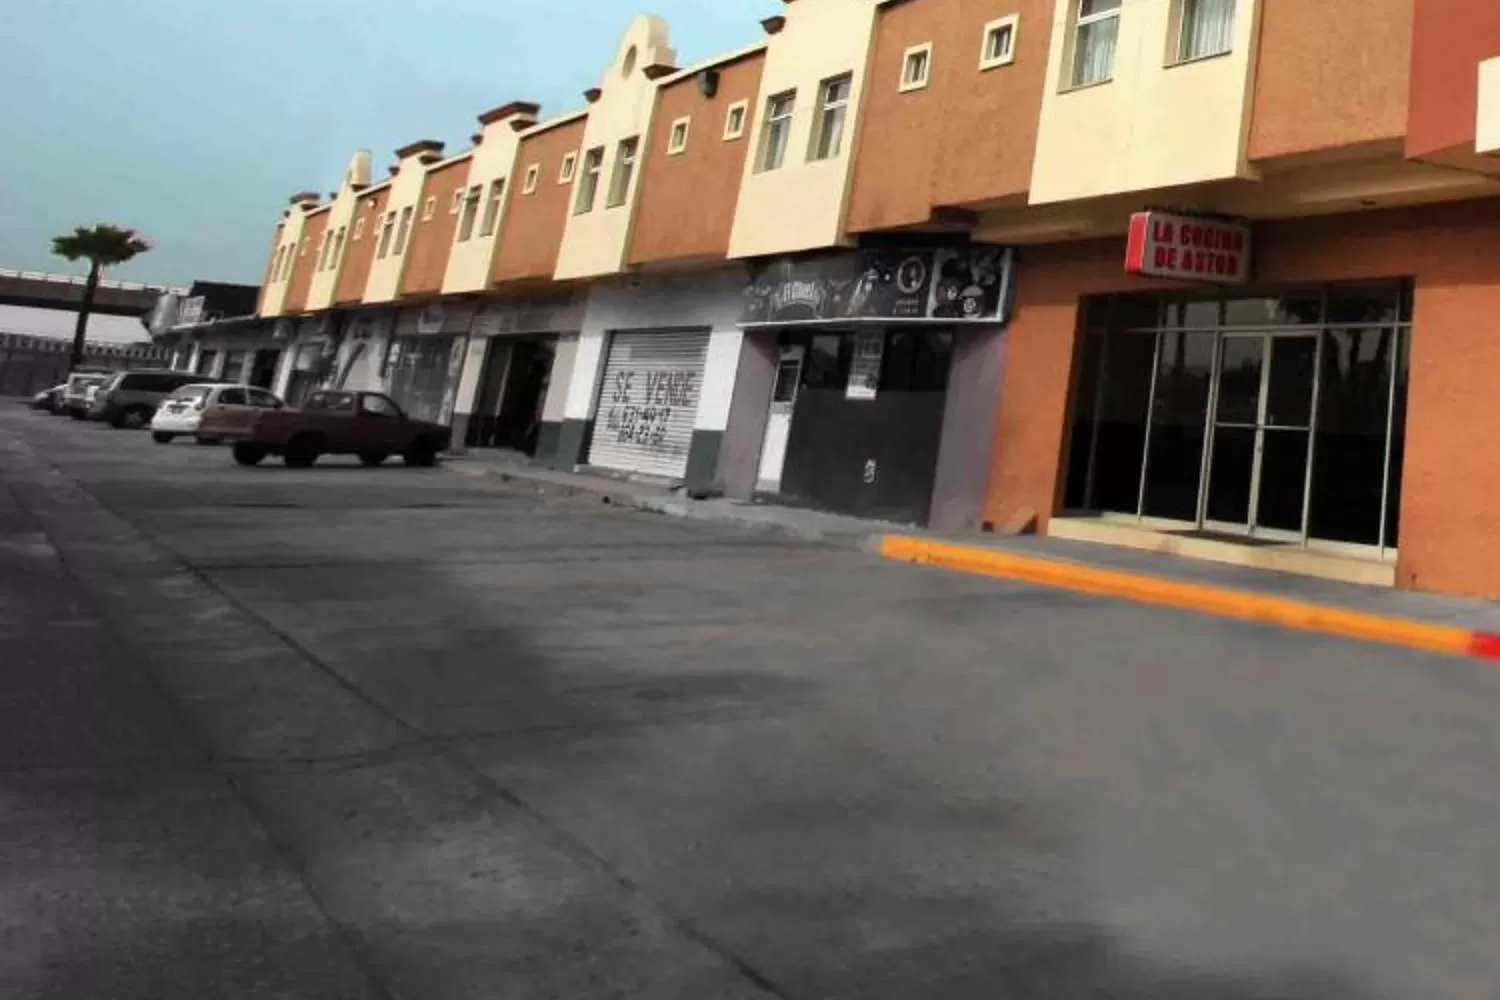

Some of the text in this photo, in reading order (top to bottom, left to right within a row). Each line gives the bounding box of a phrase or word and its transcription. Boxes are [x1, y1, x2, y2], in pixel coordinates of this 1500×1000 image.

[1153, 220, 1173, 243] LA
[1154, 246, 1177, 270] DE
[613, 369, 698, 406] SE VENDE
